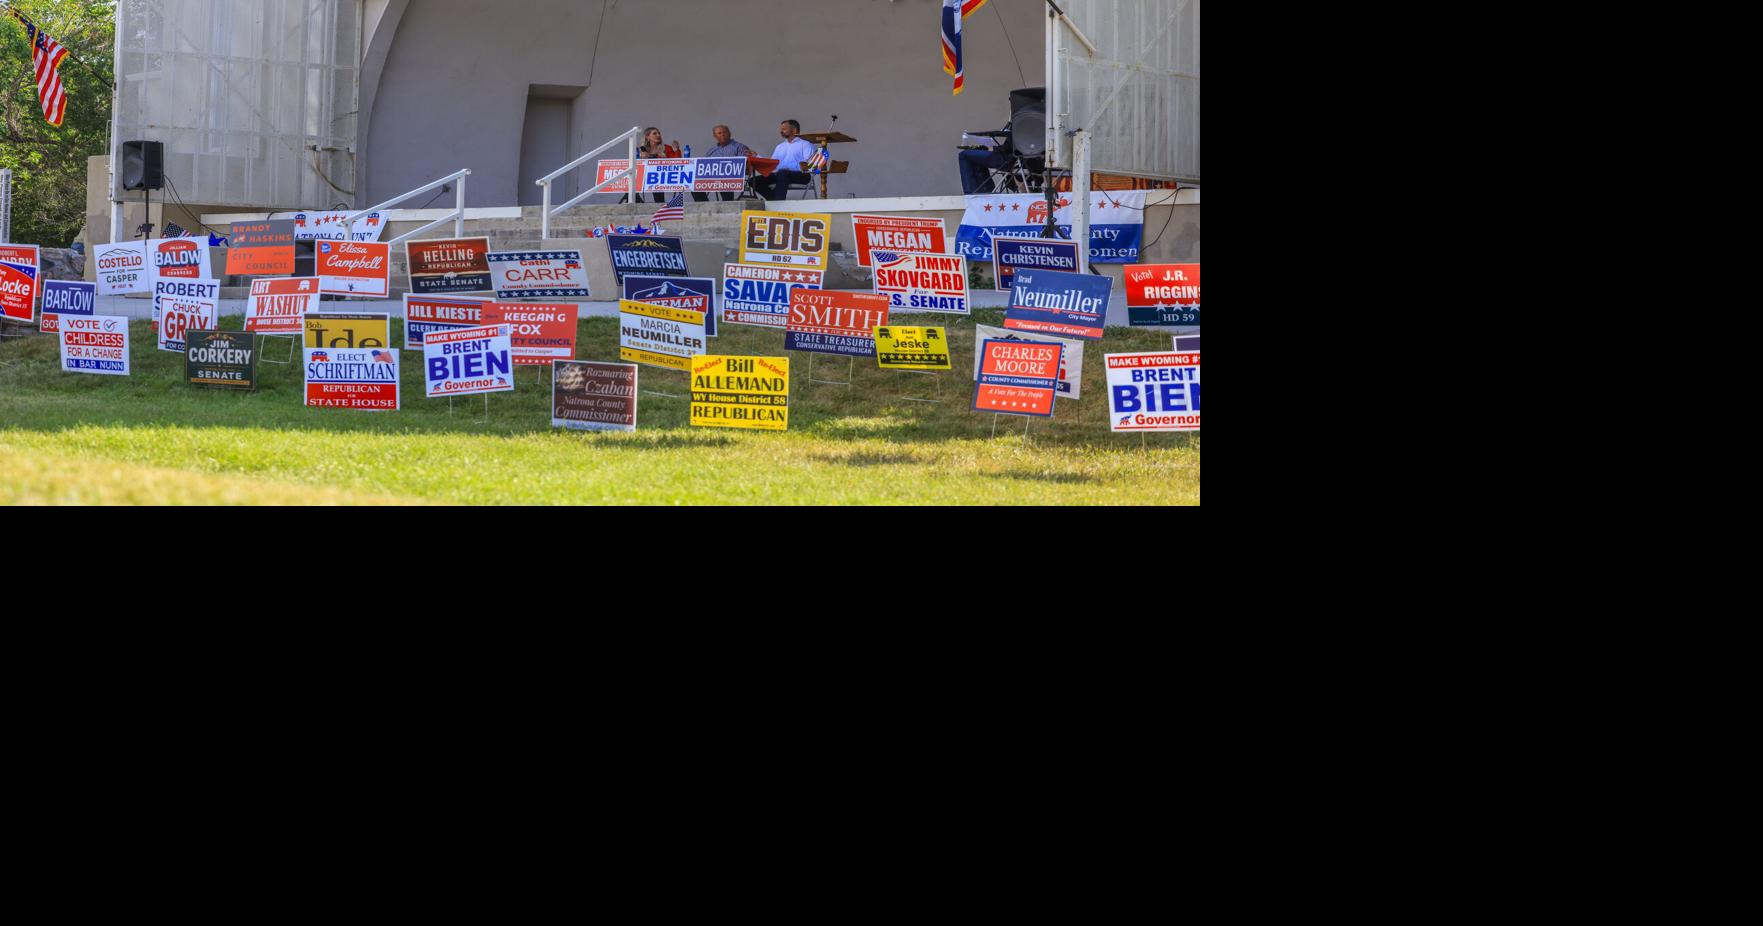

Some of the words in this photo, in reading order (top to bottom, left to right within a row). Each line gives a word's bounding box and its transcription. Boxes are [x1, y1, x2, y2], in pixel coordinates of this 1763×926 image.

[697, 163, 743, 176] BARLOW
[647, 171, 693, 185] BIEN
[695, 182, 742, 190] GOVERNOR
[233, 224, 270, 233] BRANDY
[746, 216, 826, 253] EDIS
[250, 234, 292, 242] HASKINS
[867, 230, 932, 249] MEGAN
[339, 242, 368, 253] Elissa
[1020, 246, 1053, 255] KEVIN
[1089, 247, 1138, 258] omen
[154, 250, 201, 266] BALOW
[423, 249, 474, 262] HELLING
[612, 250, 685, 270] ENGEBRETSEN
[1002, 253, 1073, 268] CHRISTENSEN
[99, 256, 142, 269] COSTELLO
[246, 262, 288, 270] COUNCIL
[326, 255, 383, 272] Campbell
[915, 256, 961, 271] JIMMY
[106, 273, 137, 283] CASPER
[505, 268, 571, 282] CARR
[727, 266, 780, 280] CAMERON
[877, 269, 964, 290] SKOVGARD
[1018, 275, 1032, 284] Brad
[1163, 270, 1188, 281] J.R.
[156, 281, 216, 298] ROBERT
[253, 281, 271, 294] ART
[1144, 286, 1200, 299] RIGGIN
[45, 289, 93, 311] BARLOW
[256, 295, 310, 316] WASHUT
[794, 293, 834, 305] SCOTT
[910, 295, 965, 310] SENATE
[1013, 286, 1102, 314] Neumiller
[173, 303, 201, 314] CHUCK
[409, 304, 433, 318] JILL
[650, 307, 672, 317] VOTE
[726, 300, 772, 312] Natrona
[504, 312, 554, 322] KEEGAN
[557, 313, 566, 322] G
[791, 304, 884, 330] SMITH
[1163, 313, 1179, 322] HD
[1183, 313, 1195, 321] 59
[67, 320, 100, 329] VOTE
[165, 311, 208, 340] GRAY
[510, 323, 541, 335] FOX
[641, 319, 680, 334] MARCIA
[65, 332, 123, 346] CHILDRESS
[309, 328, 382, 348] Ide
[427, 334, 448, 342] MAKE
[450, 330, 486, 340] WYOMING
[488, 328, 497, 336] #1
[622, 326, 702, 349] NEUMILLER
[795, 333, 820, 343] STATE
[824, 336, 875, 348] TREASURER
[166, 342, 176, 350] FOR
[210, 340, 229, 349] JIM
[443, 339, 491, 355] BRENT
[628, 339, 651, 348] Senate
[796, 342, 836, 351] CONSERVATIVE
[838, 346, 872, 354] REPUBLICAN
[893, 339, 929, 348] Jeske
[67, 347, 82, 357] FOR
[85, 348, 90, 357] A
[92, 348, 122, 359] CHANGE
[189, 347, 251, 364] CORKERY
[337, 353, 366, 361] ELECT
[640, 353, 684, 366] REPUBLICAN
[992, 346, 1053, 361] CHARLES
[67, 359, 75, 367] IN
[100, 361, 124, 370] NUNN
[428, 350, 509, 381] BIEN
[726, 359, 754, 373] Bill
[995, 360, 1046, 374] MOORE
[1109, 357, 1139, 367] MAKE
[1141, 355, 1189, 366] WYOMING
[198, 370, 242, 380] SENATE
[308, 363, 395, 380] SCHRIFTMAN
[1132, 368, 1196, 382] BRENT
[323, 385, 380, 393] REPUBLICAN
[444, 378, 494, 390] Governor
[585, 380, 633, 395] Czaban
[694, 375, 785, 392] ALLEMAND
[309, 398, 348, 406] STATE
[351, 399, 394, 407] HOUSE
[563, 396, 594, 406] Natrona
[596, 398, 626, 410] County
[693, 393, 707, 401] WY
[709, 394, 736, 403] House
[739, 395, 771, 404] District
[773, 396, 786, 405] 58
[555, 406, 632, 422] Commissioner
[693, 406, 785, 422] REPUBLICAN
[1135, 414, 1200, 426] Governor
